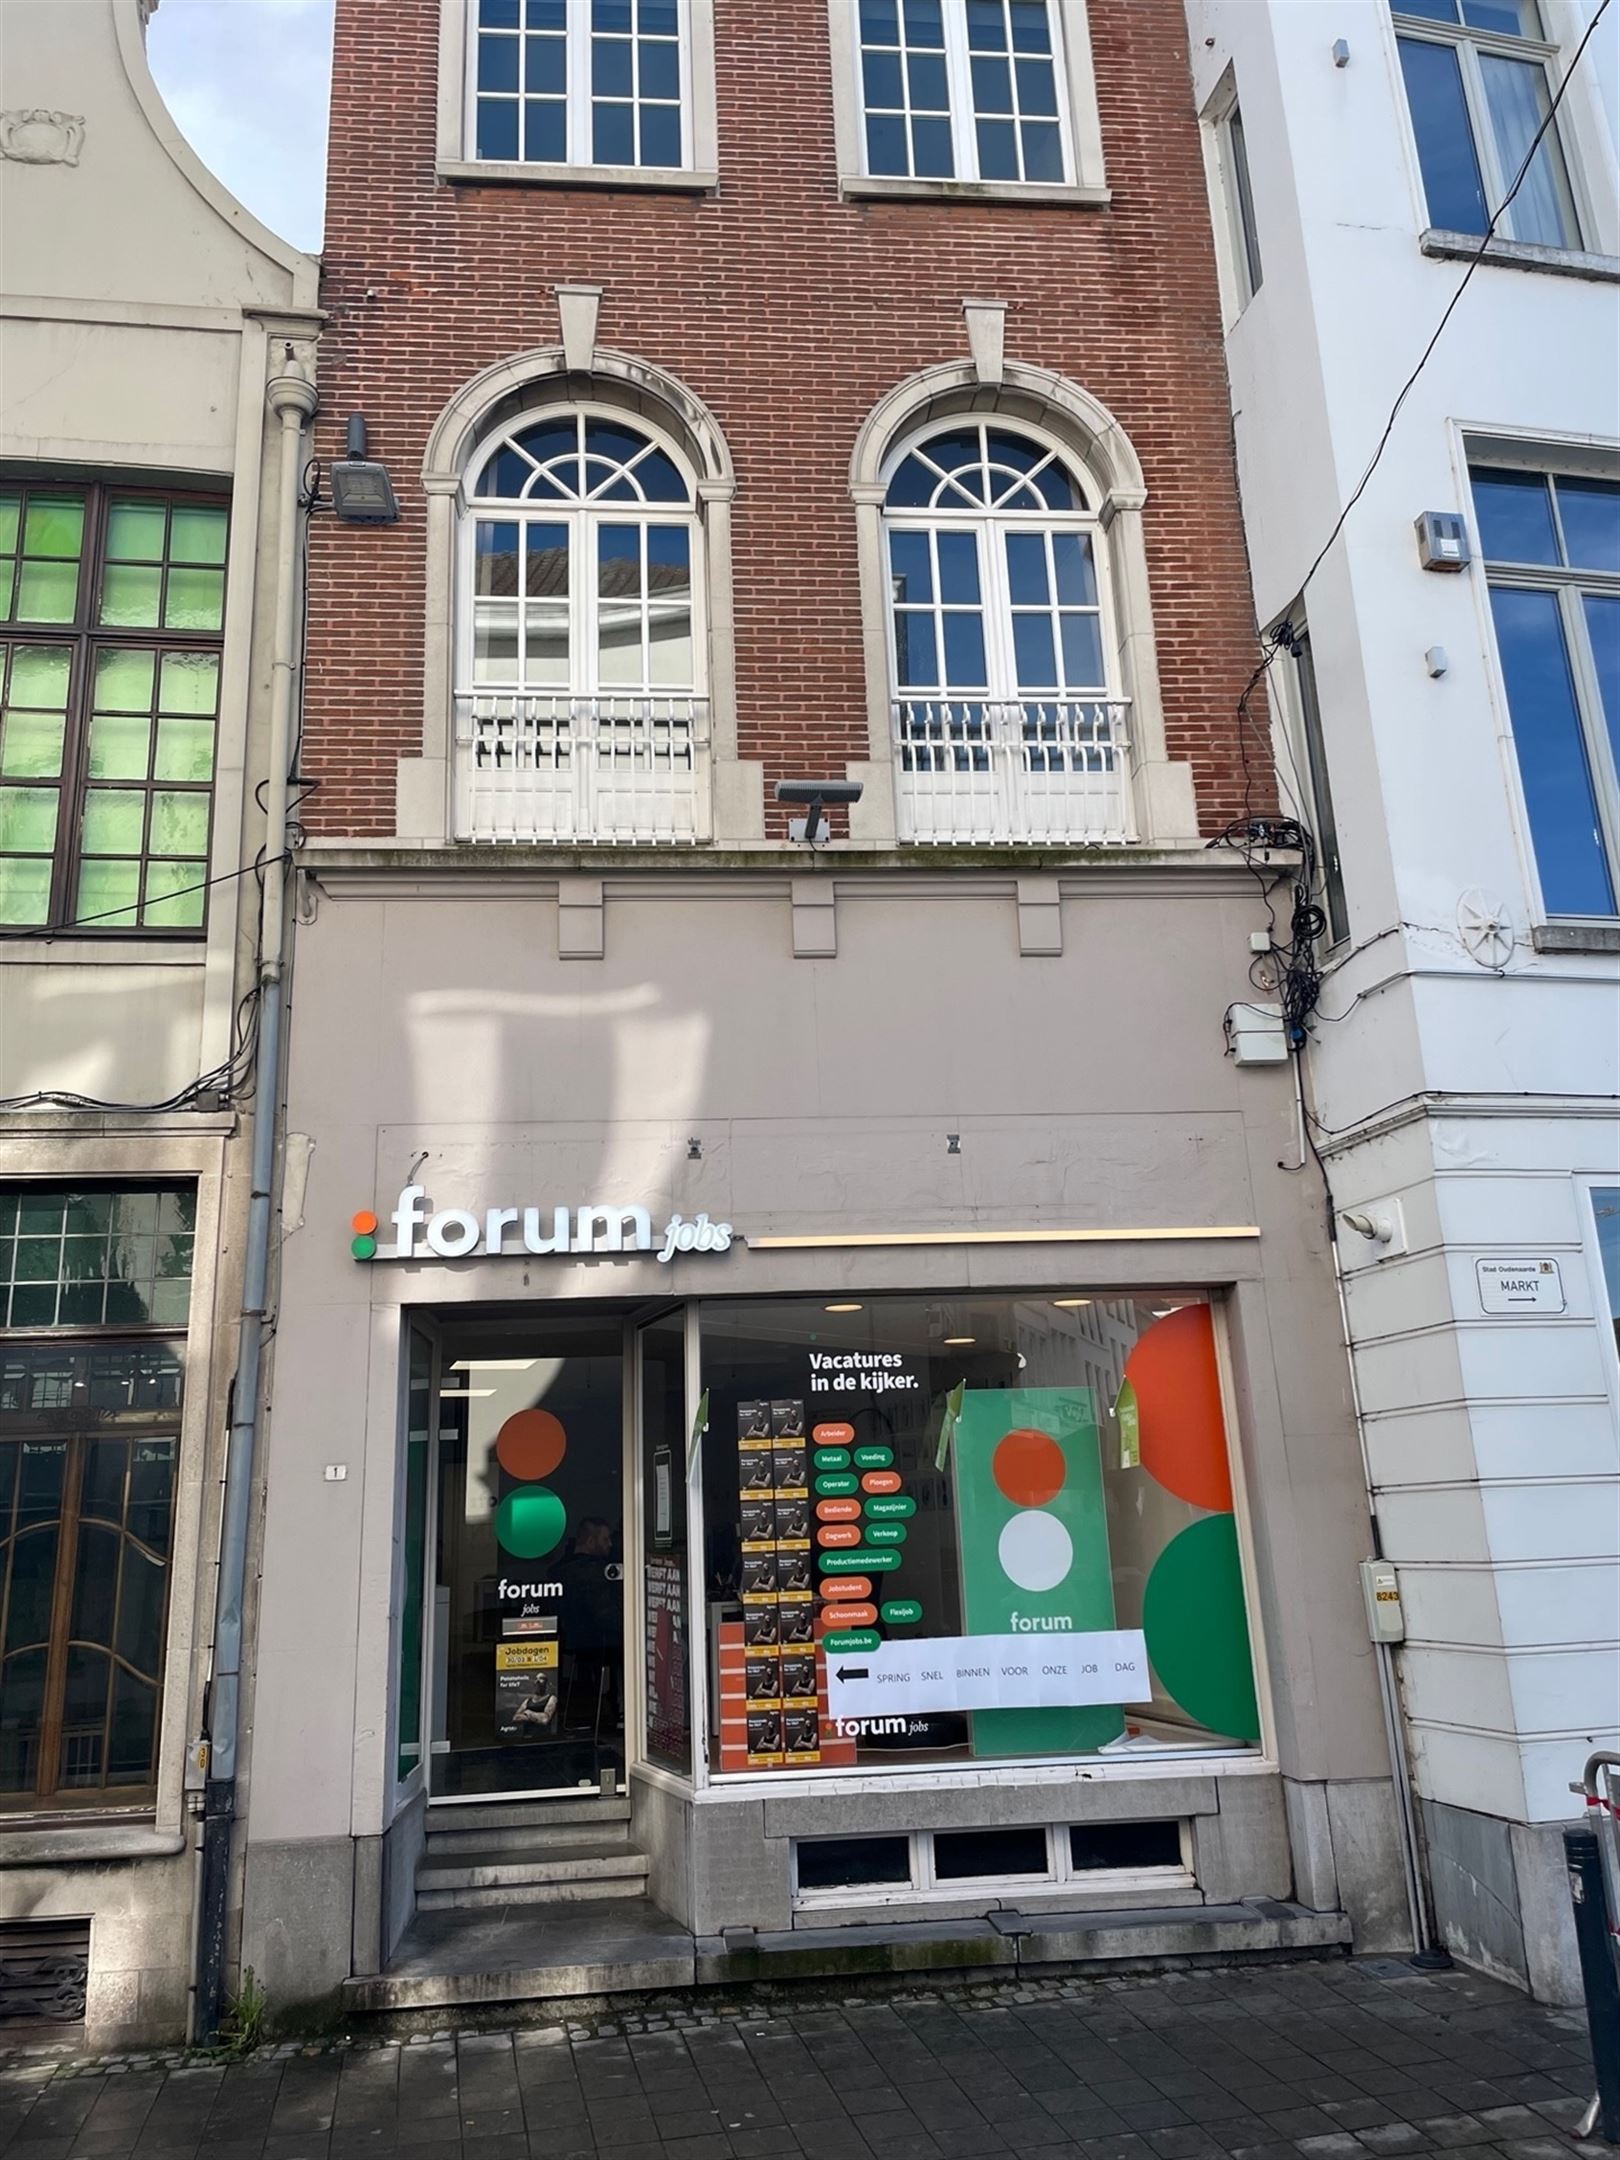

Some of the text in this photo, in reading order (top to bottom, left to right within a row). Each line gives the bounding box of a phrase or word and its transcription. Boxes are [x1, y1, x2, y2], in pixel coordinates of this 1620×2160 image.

[391, 1185, 734, 1263] forum jobs
[1482, 1265, 1536, 1273] Stad Oudenaarde
[1500, 1280, 1539, 1292] MARKT
[809, 1352, 903, 1369] Vacatures
[811, 1371, 919, 1394] in de kijker.
[861, 1453, 886, 1462] Voeding
[822, 1480, 850, 1489] Operator
[824, 1505, 853, 1513] Bediende
[873, 1503, 907, 1513] Magazijnier
[872, 1530, 898, 1538] Verkoop
[498, 1577, 563, 1600] forum
[520, 1603, 540, 1617] jobs
[829, 1610, 868, 1619] Schoonmaak
[1010, 1611, 1073, 1632] forum
[830, 1637, 872, 1647] Forumjobs.be
[505, 1647, 550, 1656] Jobdagen
[877, 1662, 1135, 1684] SPRING SNEL BINNEN VOOR ONZE JOB DAG
[836, 1714, 929, 1737] forum jobs
